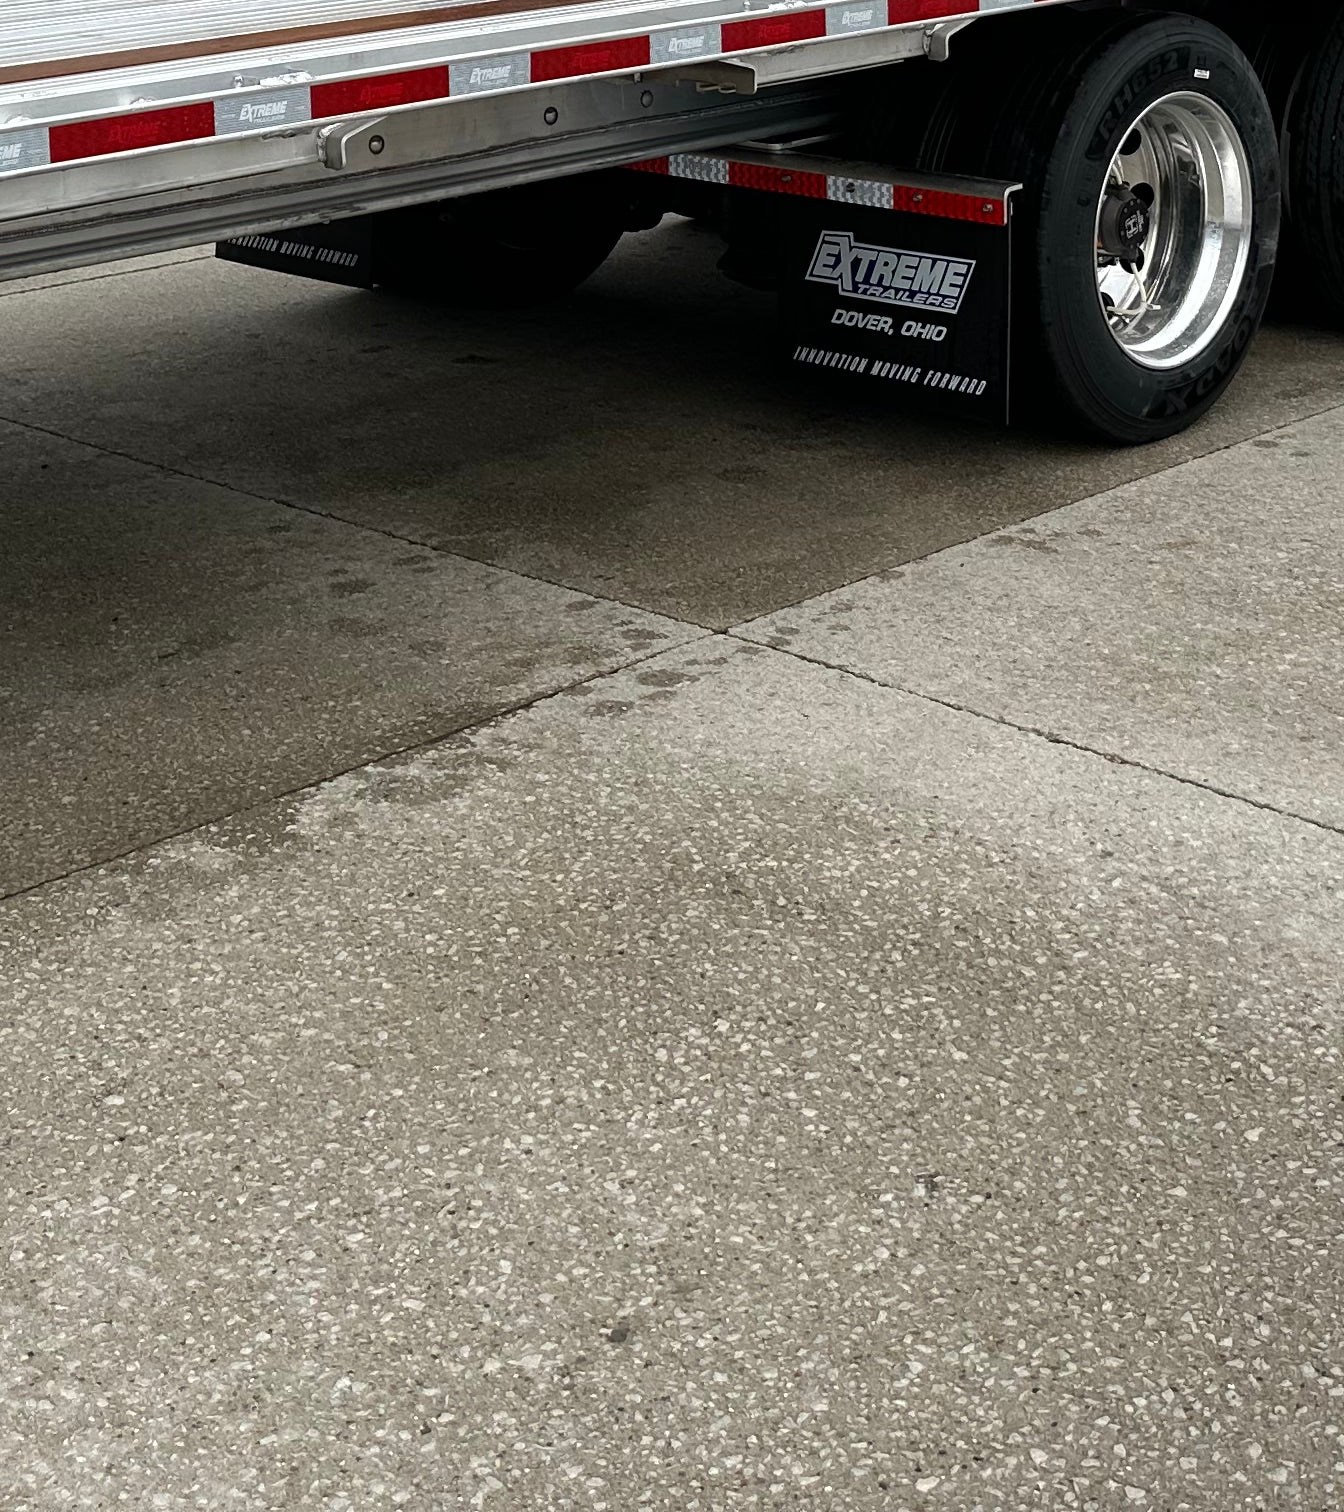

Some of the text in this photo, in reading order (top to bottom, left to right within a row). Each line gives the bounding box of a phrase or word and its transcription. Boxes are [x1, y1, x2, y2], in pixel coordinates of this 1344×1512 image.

[239, 100, 288, 123] EXTREME
[279, 241, 315, 259] MOVING
[315, 247, 359, 267] FORWARD
[813, 235, 969, 297] EXTREME
[856, 283, 958, 309] TRAILERS
[830, 308, 947, 342] DOVER, OHIO
[792, 345, 987, 396] INNOVATION MOVING FORWARD
